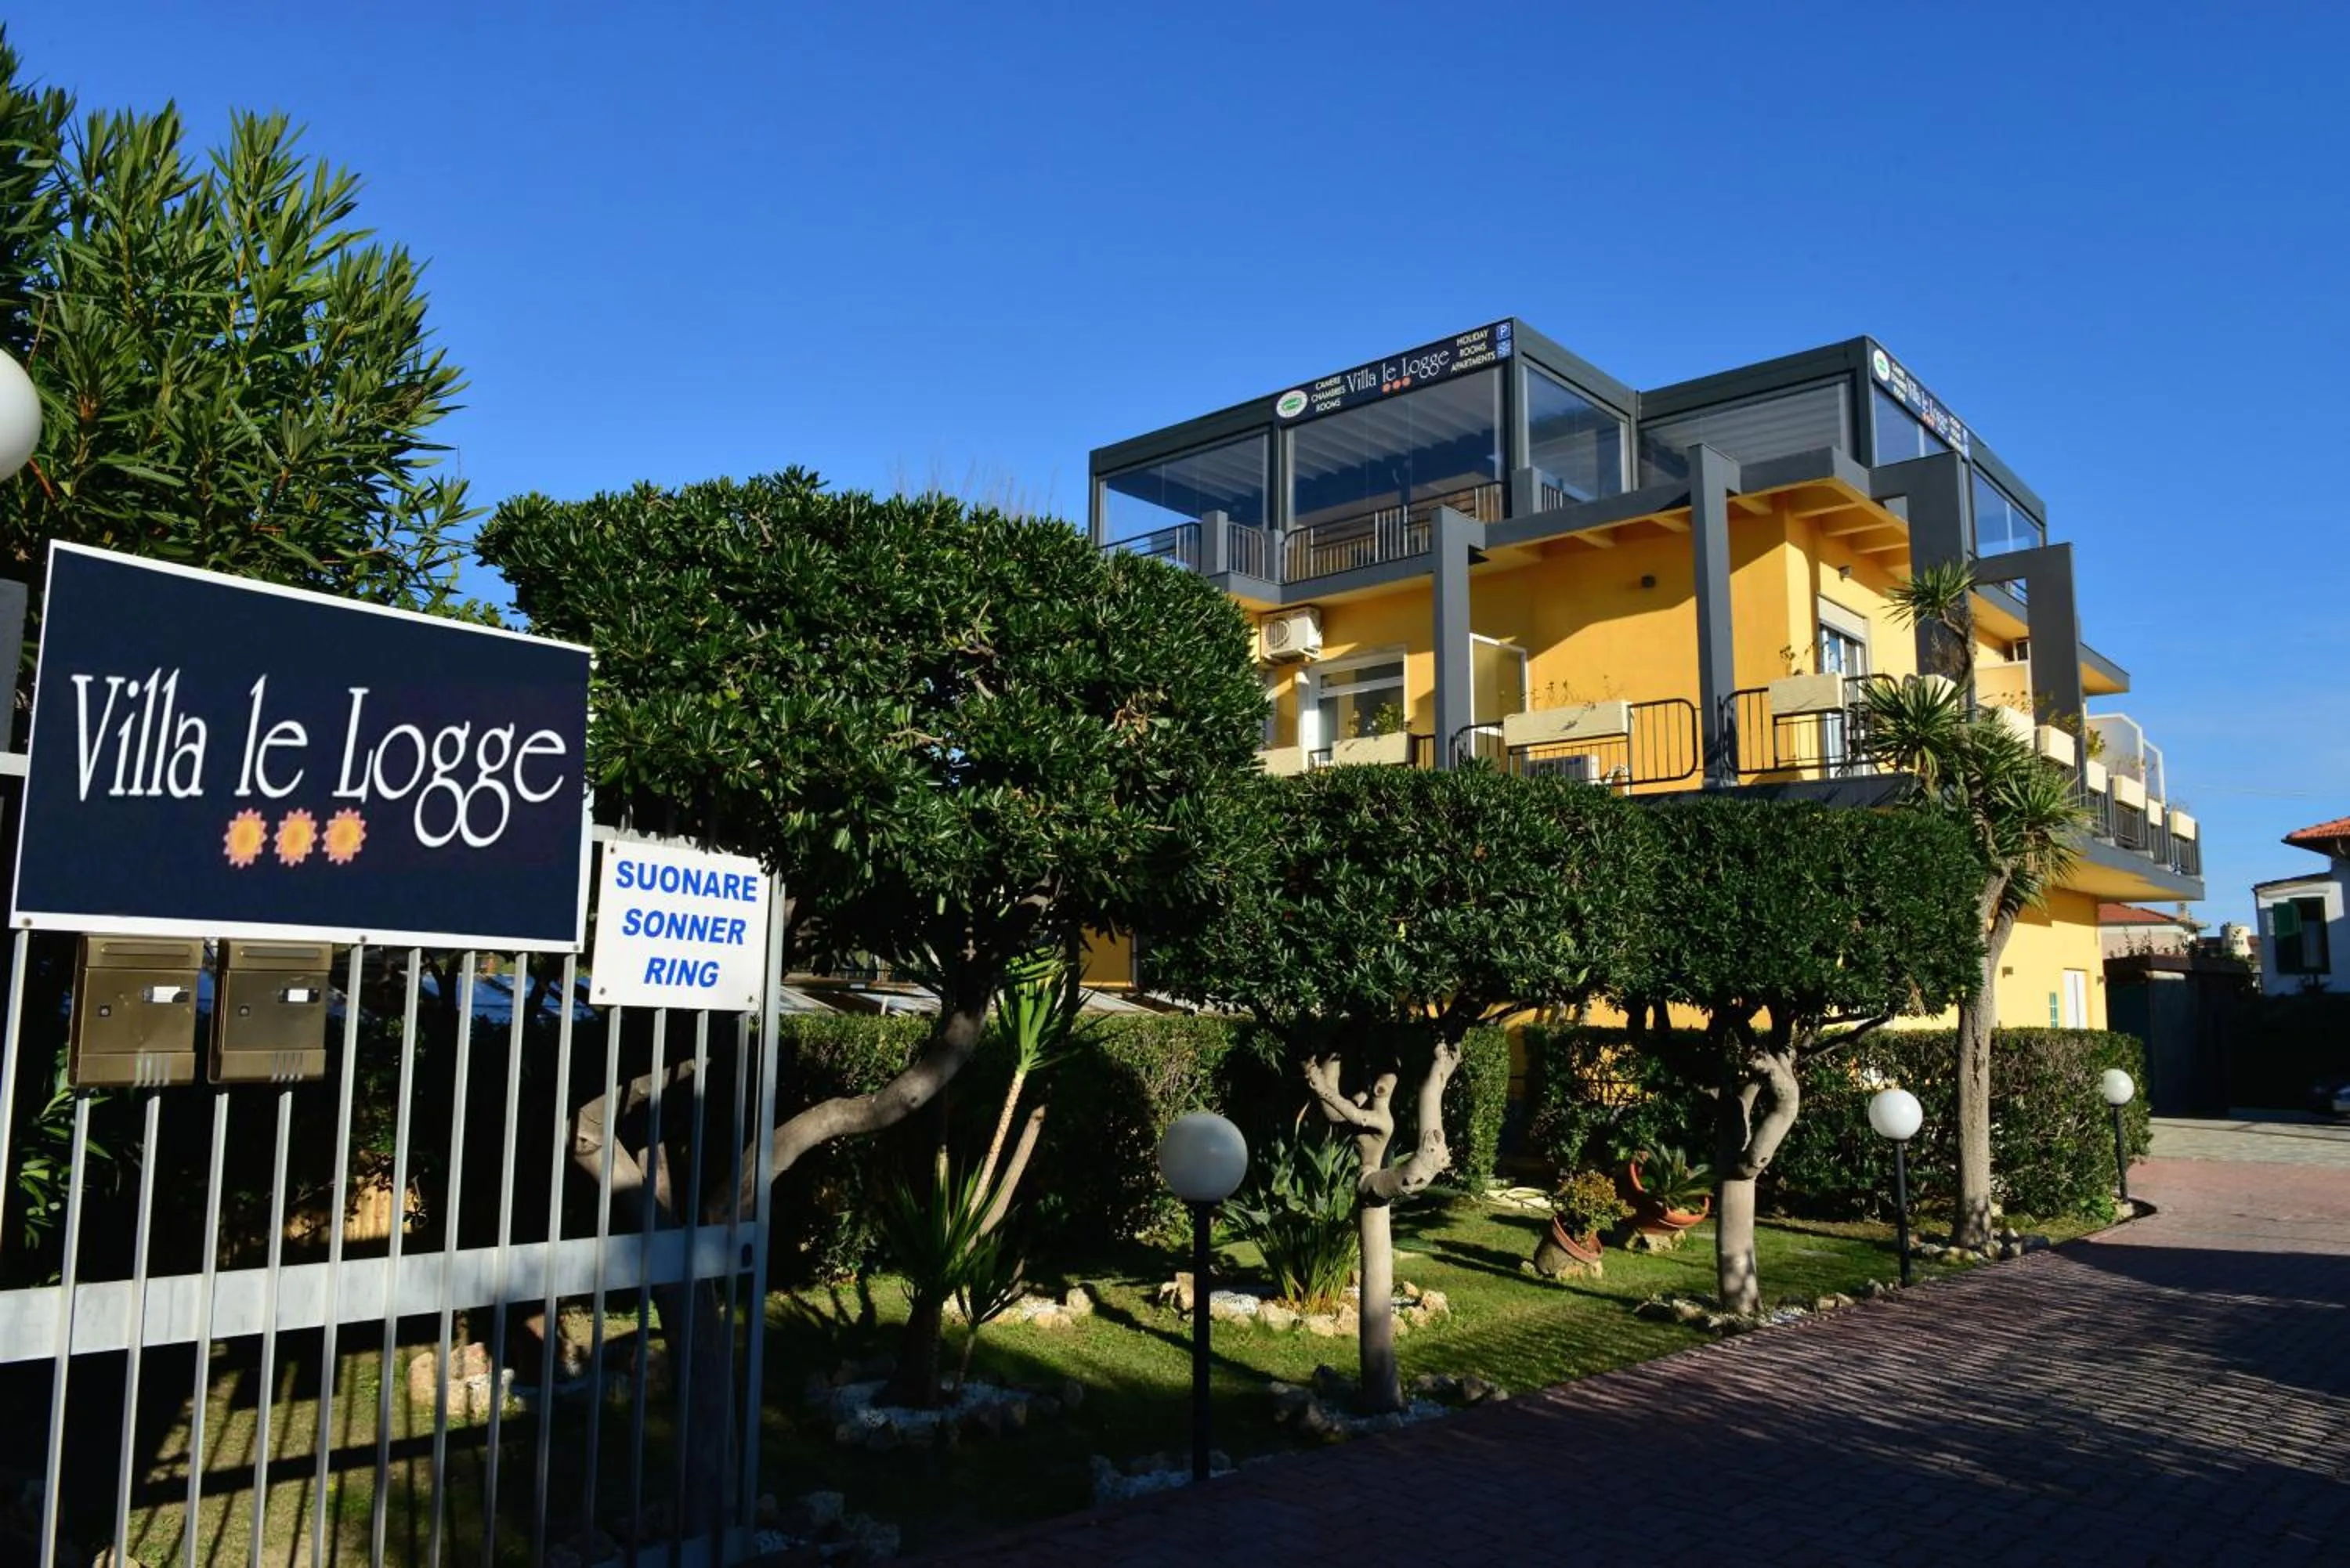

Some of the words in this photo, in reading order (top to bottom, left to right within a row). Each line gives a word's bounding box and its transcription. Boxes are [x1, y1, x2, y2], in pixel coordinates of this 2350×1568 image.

[1457, 328, 1488, 347] HOLIDAY
[1459, 341, 1487, 358] ROOMS
[1347, 368, 1376, 392] Villa
[1382, 363, 1396, 383] le
[1401, 350, 1449, 379] Logge
[1451, 351, 1495, 373] APARTMENTS
[1316, 397, 1342, 412] ROOMS
[71, 667, 207, 801] Villa
[235, 674, 308, 798] le
[332, 687, 566, 848] Logge
[615, 860, 758, 903] SUONARE
[621, 908, 747, 945] SONNER
[643, 956, 720, 988] RING
